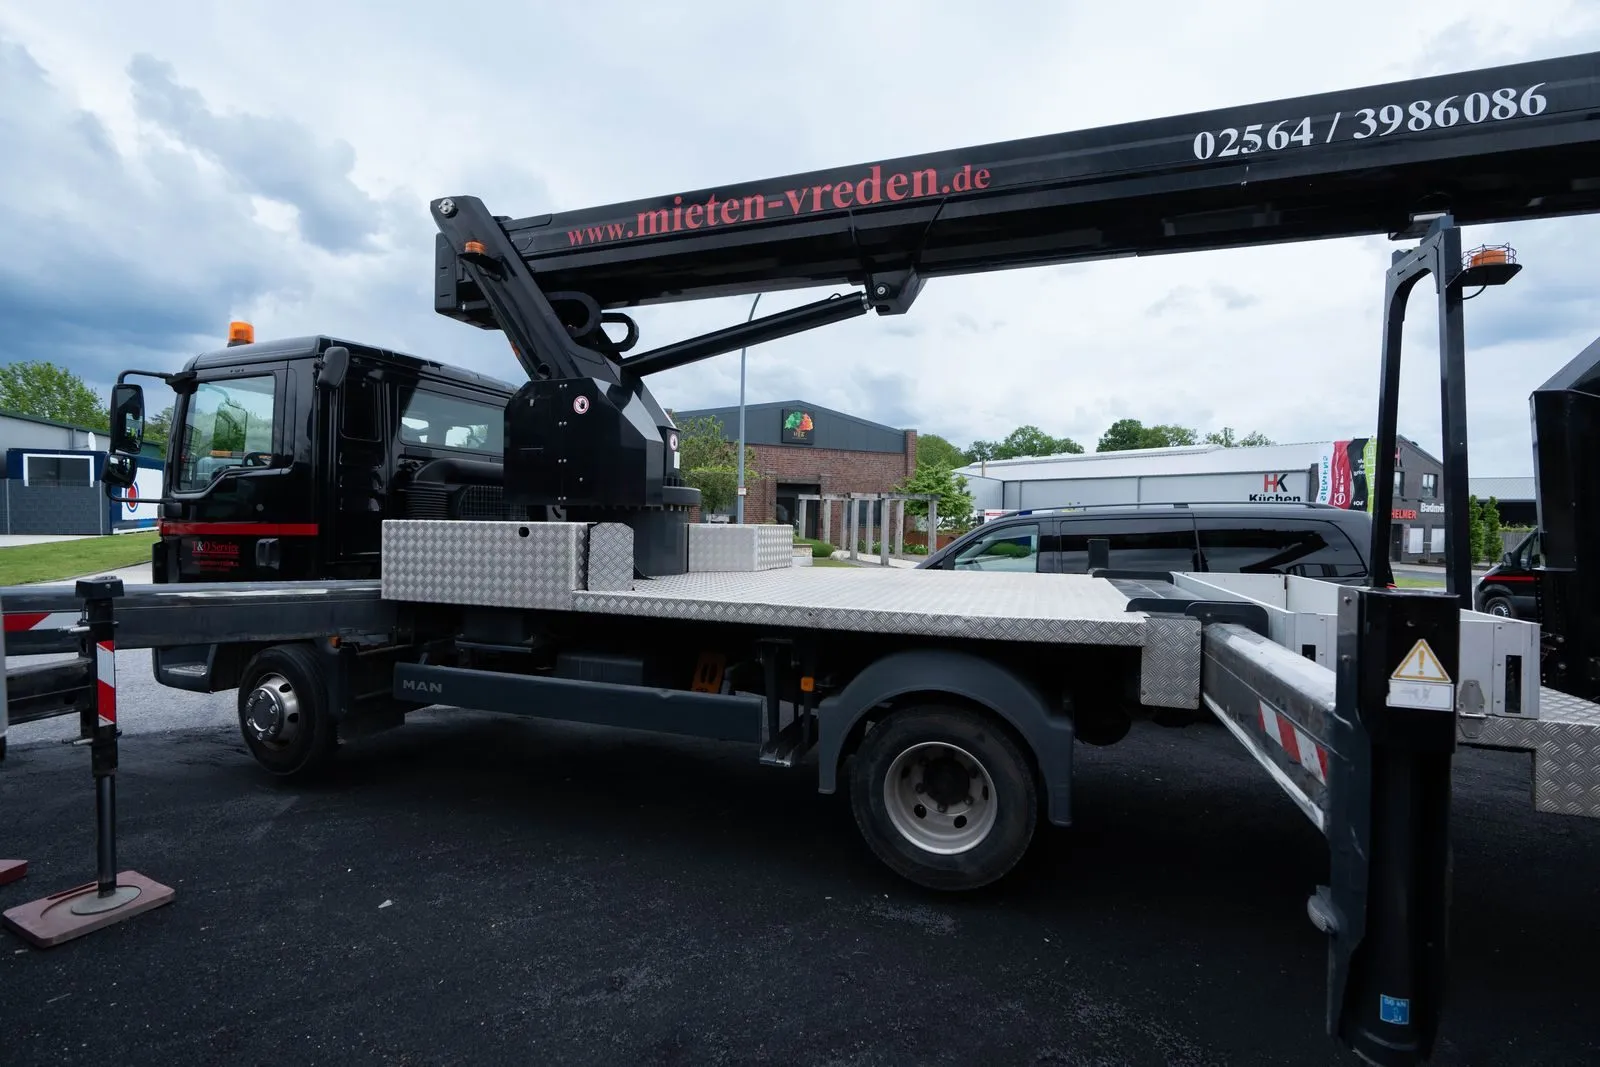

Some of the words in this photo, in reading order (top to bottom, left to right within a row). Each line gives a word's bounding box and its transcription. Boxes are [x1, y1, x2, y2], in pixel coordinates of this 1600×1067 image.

[1193, 116, 1314, 160] 02564
[1353, 82, 1547, 139] 3986086
[567, 164, 991, 247] www.mieten-vreden.de
[1264, 473, 1288, 492] HK
[1249, 494, 1301, 502] Küchen
[403, 680, 442, 693] MAN
